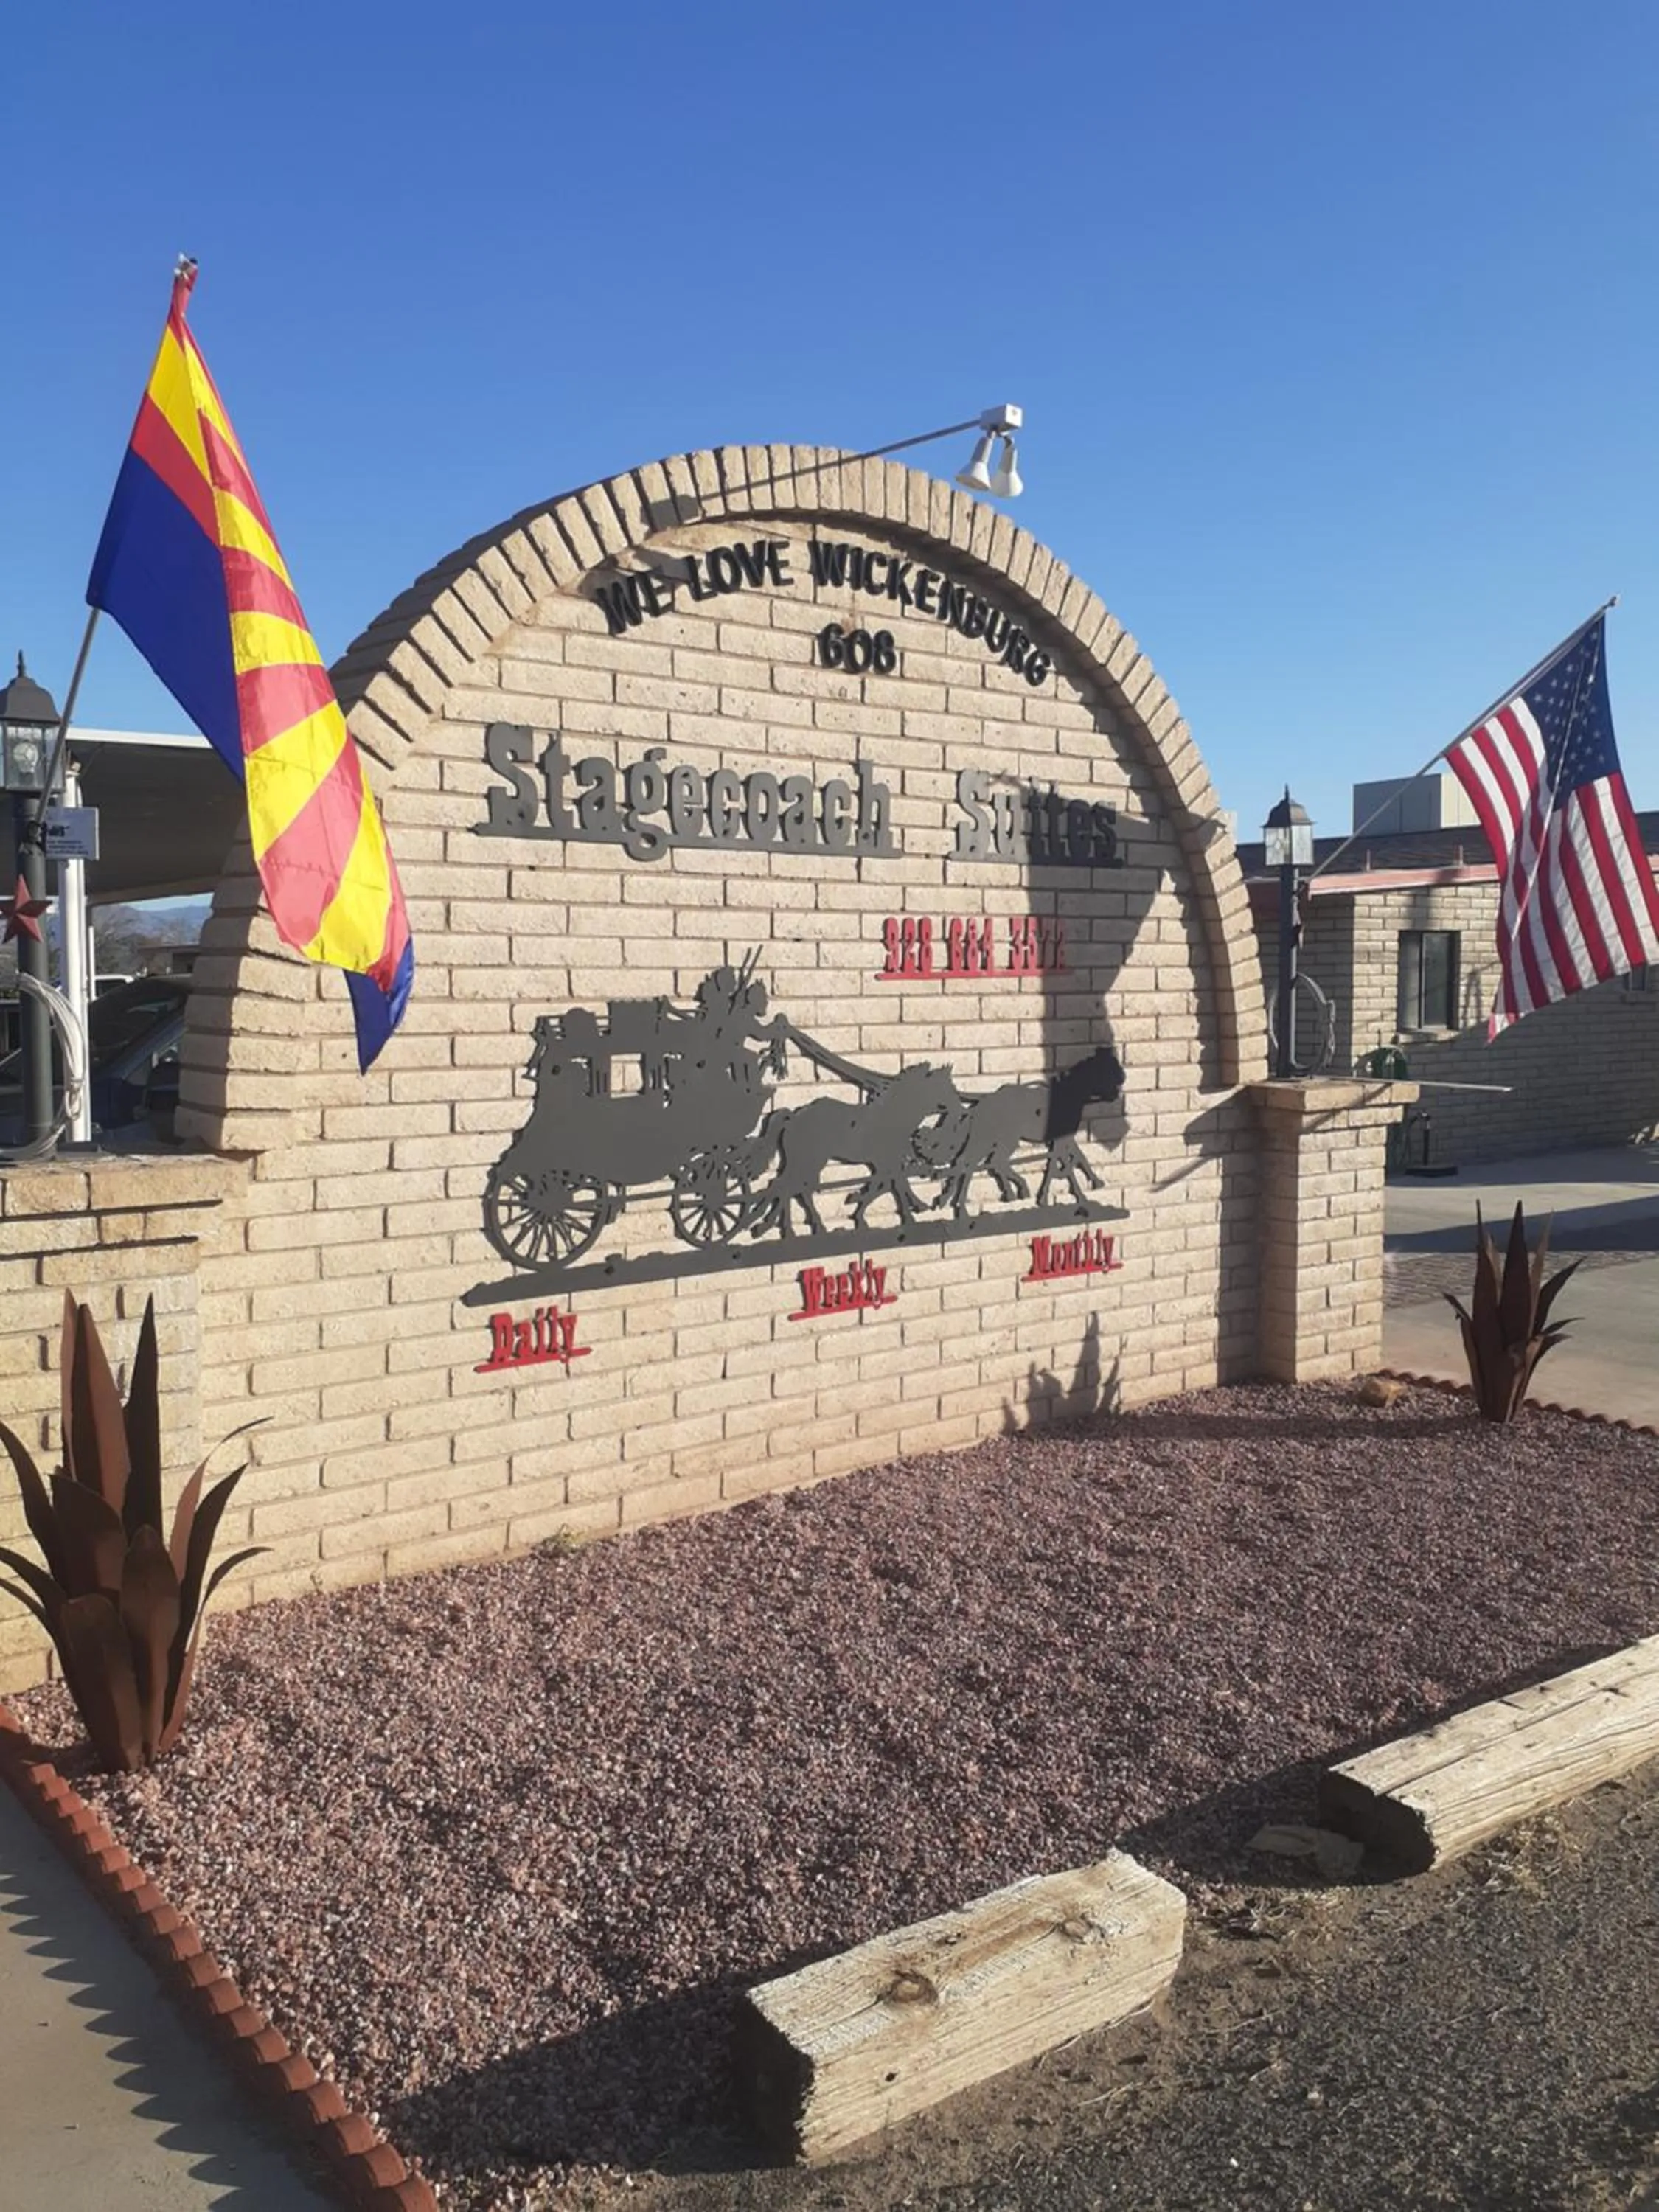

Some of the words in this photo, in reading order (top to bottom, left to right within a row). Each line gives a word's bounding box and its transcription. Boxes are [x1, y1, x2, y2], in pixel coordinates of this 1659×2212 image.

[596, 571, 673, 636] WE
[684, 539, 794, 602] LOVE
[807, 540, 1051, 687] WICKENBURG
[816, 622, 897, 675] 608
[484, 721, 895, 861] Stagecoach
[956, 767, 1118, 864] Suites
[883, 917, 933, 973] 928
[947, 917, 995, 971] 684
[1029, 1228, 1115, 1274] Monthly
[796, 1257, 887, 1310] Weekly
[489, 1304, 577, 1364] Daily
